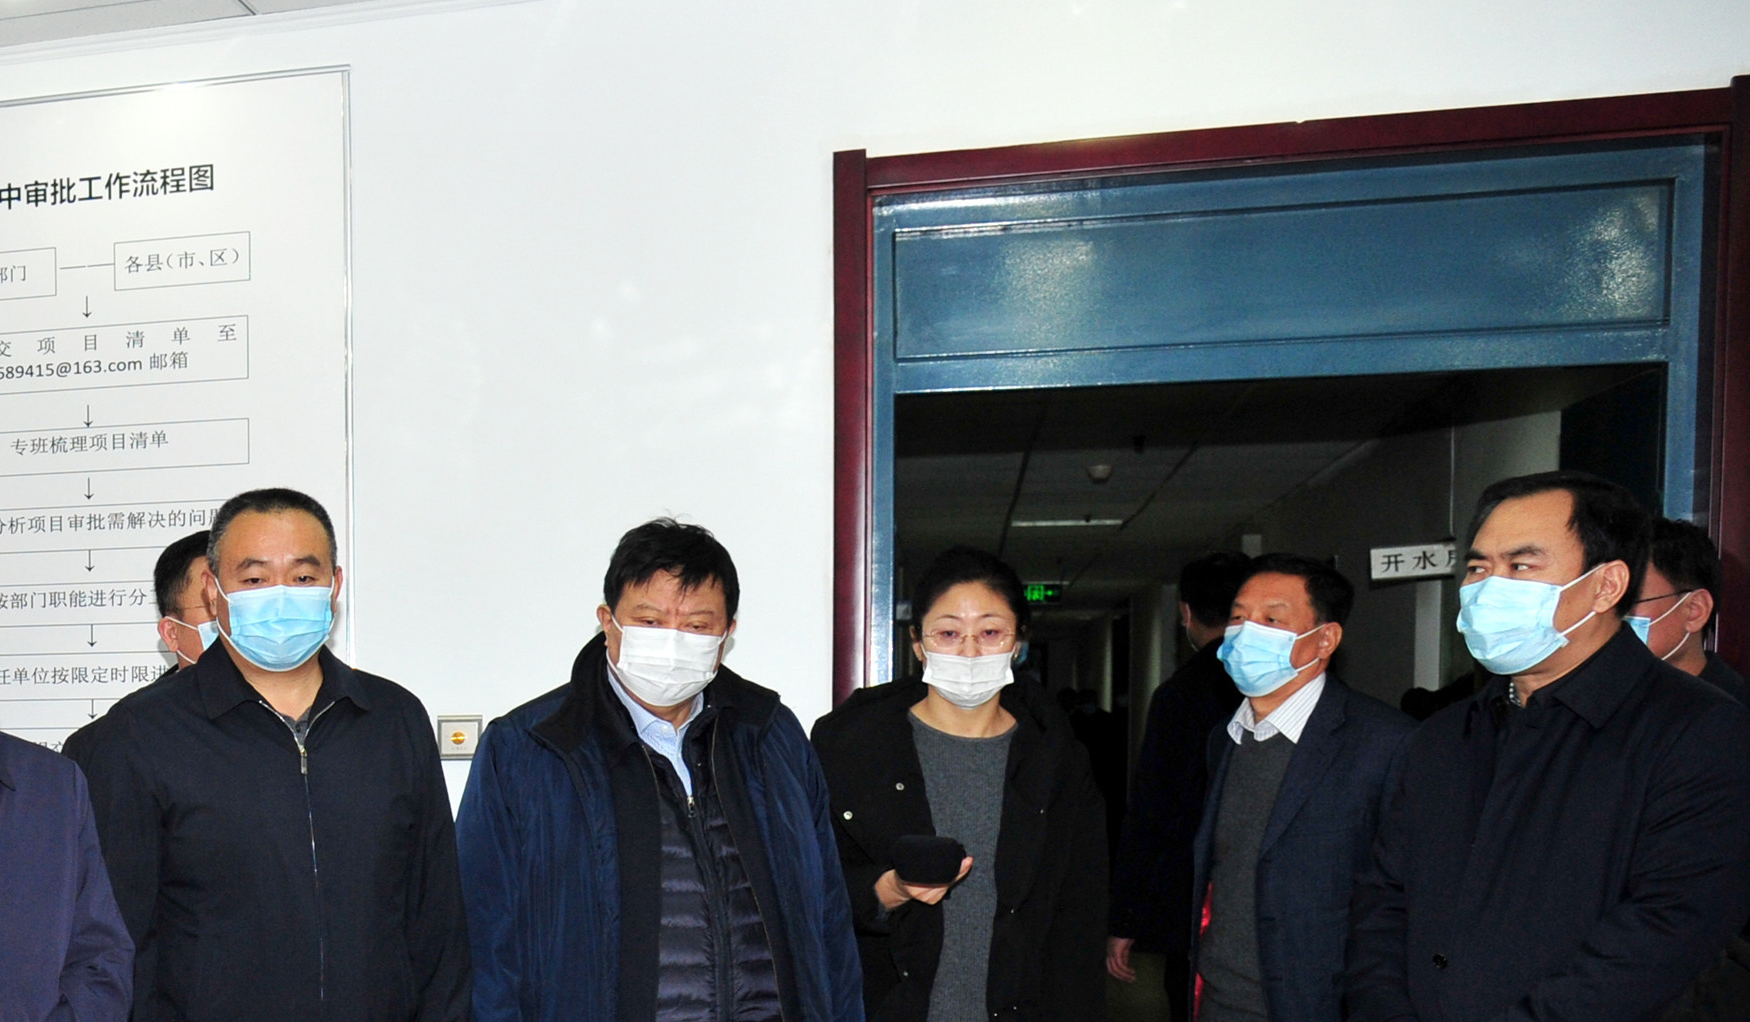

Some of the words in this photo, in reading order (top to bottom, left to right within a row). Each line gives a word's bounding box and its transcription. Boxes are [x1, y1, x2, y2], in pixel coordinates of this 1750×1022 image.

[125, 248, 240, 274] 各县（市、区）
[149, 351, 189, 370] 邮箱
[10, 430, 169, 456] 专班梳理项目清单
